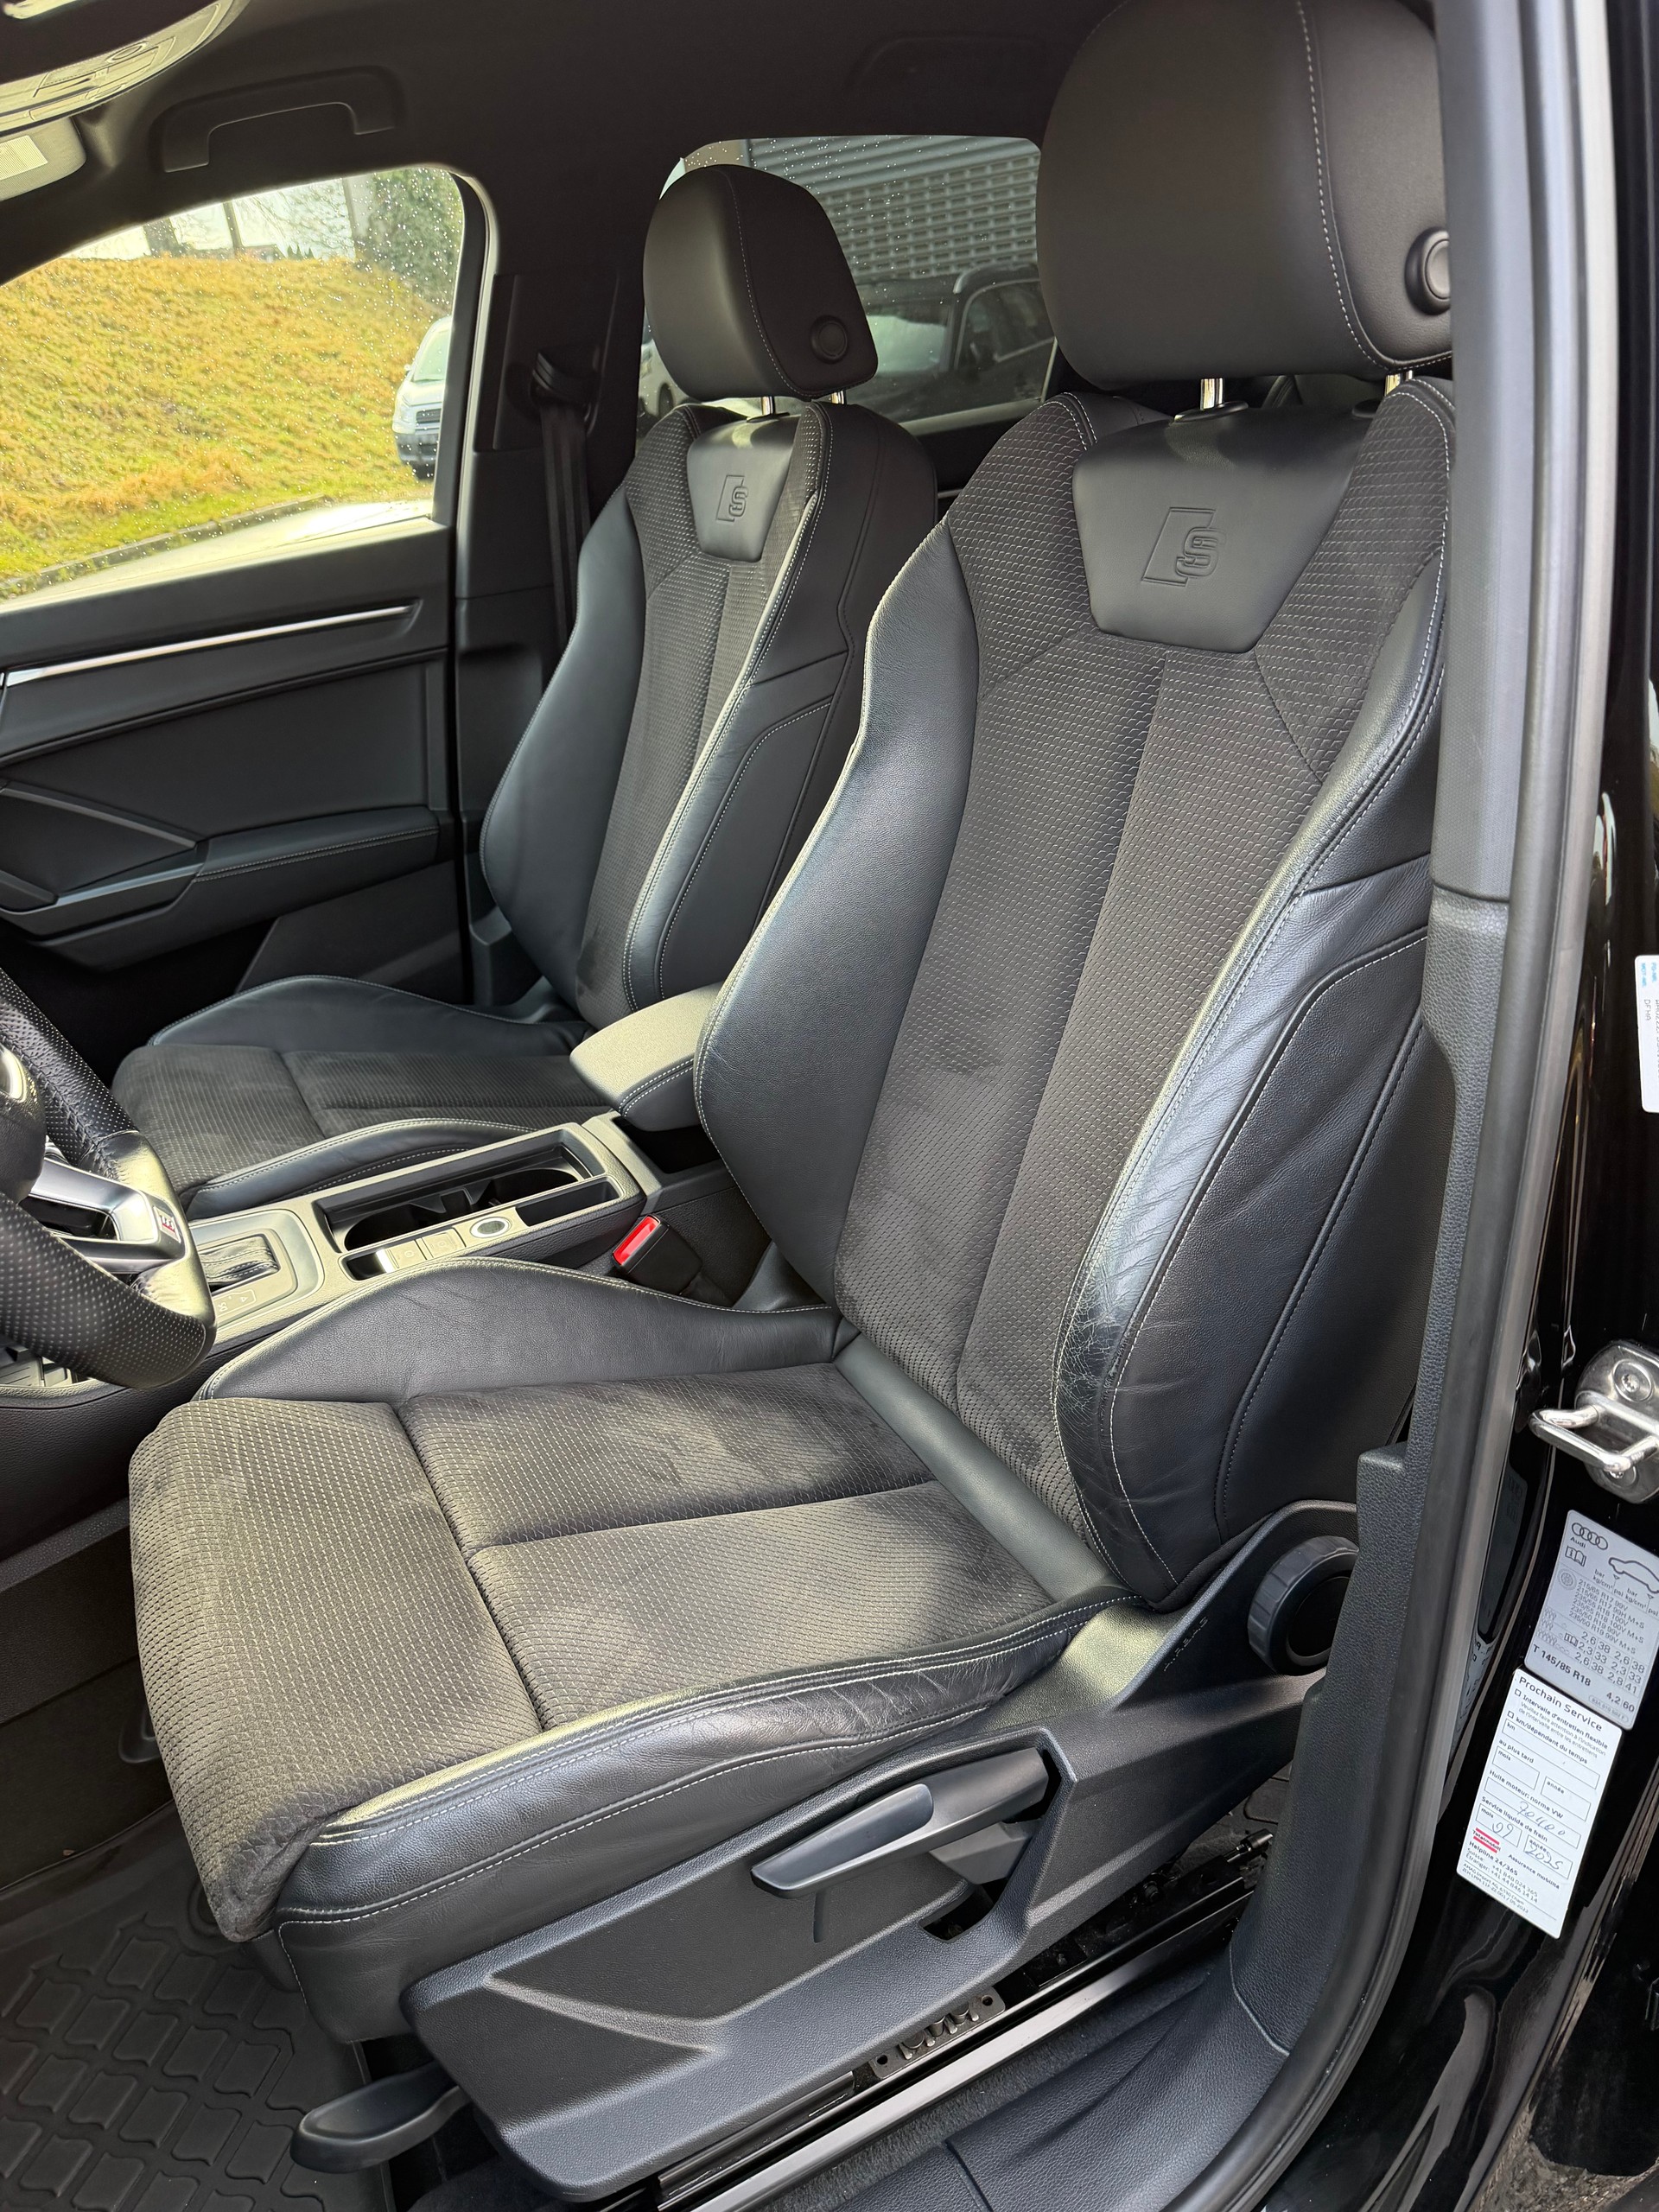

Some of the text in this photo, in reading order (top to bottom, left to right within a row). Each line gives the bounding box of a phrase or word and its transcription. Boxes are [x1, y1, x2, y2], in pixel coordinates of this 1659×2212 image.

[1570, 1536, 1586, 1548] Audi
[1578, 1578, 1629, 1611] 215/65 R17 99V
[1594, 1568, 1637, 1597] bar bar
[1570, 1604, 1621, 1637] 235/50 R19 99V
[1573, 1598, 1643, 1643] 235/55 R18 100V M+S
[1574, 1591, 1629, 1627] 235/55 R18 100V
[1576, 1585, 1644, 1629] 215/65 R17 99H M+S
[1613, 1588, 1624, 1597] psi
[1648, 1608, 1658, 1617] psi
[1568, 1610, 1636, 1654] 235/50 R19 99V M+S
[1578, 1641, 1642, 1684] 2,3 33 2,3 33
[1580, 1630, 1645, 1674] 2,6 38 2,6 38
[1533, 1643, 1635, 1713] T 145/85 R18 4,2 60
[1574, 1651, 1637, 1694] 2,6 38 2,8 41
[1518, 1675, 1602, 1732] Prochain Service
[1522, 1694, 1551, 1715] Intervalle
[1585, 1732, 1608, 1749] flexible
[1506, 1721, 1516, 1731] km
[1516, 1716, 1587, 1764] km/dépendant du temps
[1539, 1713, 1550, 1723] faire
[1550, 1720, 1573, 1737] attention
[1550, 1727, 1564, 1738] entre
[1572, 1740, 1598, 1758] entretiens
[1497, 1750, 1564, 1794] mois année
[1507, 1745, 1520, 1755] plus
[1521, 1752, 1534, 1764] tard
[1489, 1769, 1505, 1783] Huile
[1529, 1796, 1550, 1811] norme
[1551, 1808, 1563, 1819] VW
[1481, 1808, 1494, 1818] mois
[1481, 1796, 1503, 1814] Service
[1503, 1809, 1524, 1827] liquide
[1533, 1829, 1548, 1842] frein
[1469, 1840, 1518, 1876] Helpline 24/365
[1492, 1865, 1502, 1874] +41
[1508, 1853, 1535, 1874] Assurance
[1536, 1872, 1560, 1890] mobilité
[1524, 1842, 1564, 1870] 2025
[1491, 1870, 1500, 1879] +41
